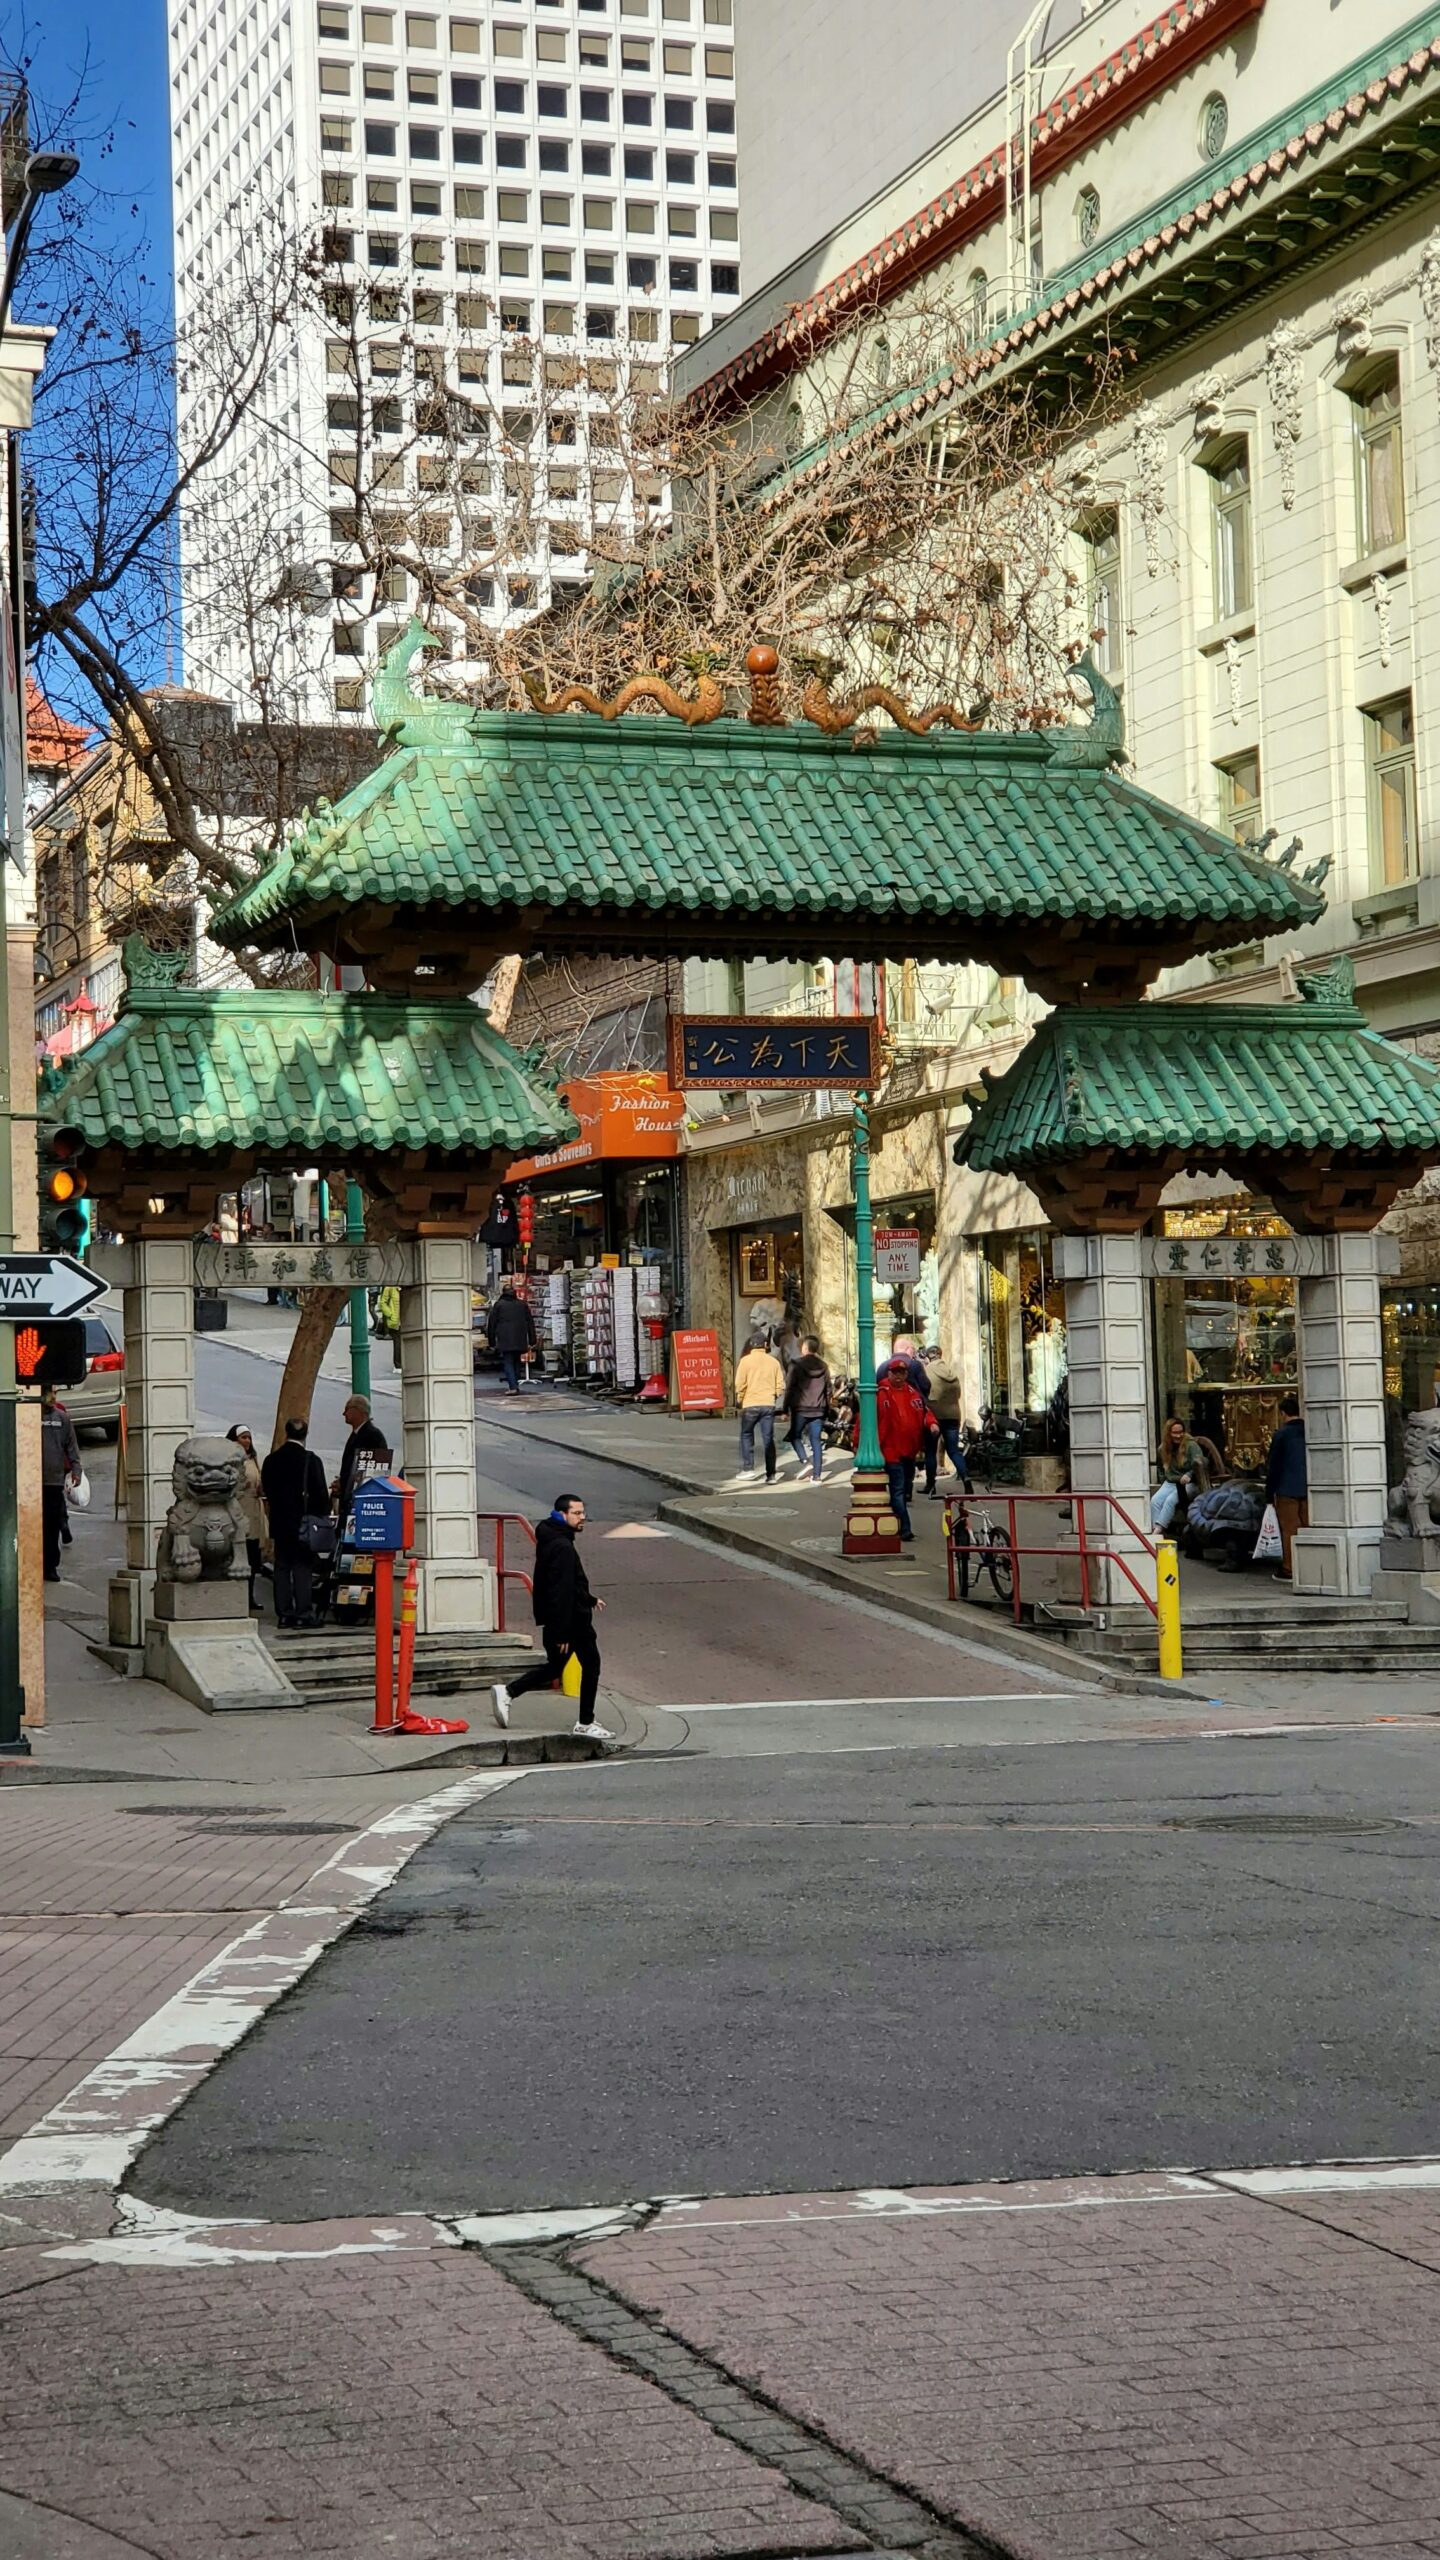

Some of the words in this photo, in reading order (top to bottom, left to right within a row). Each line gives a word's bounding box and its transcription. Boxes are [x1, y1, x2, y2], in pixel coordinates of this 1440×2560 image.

[609, 1095, 670, 1112] Fashion
[559, 1140, 593, 1163] Souvenirs
[876, 1239, 889, 1249] NO
[890, 1240, 918, 1249] STOPPING
[888, 1253, 908, 1262] ANY
[887, 1263, 910, 1272] TIME
[684, 1359, 698, 1368] UP
[700, 1358, 713, 1367] TO
[681, 1370, 698, 1378] 70%
[700, 1369, 718, 1377] OFF
